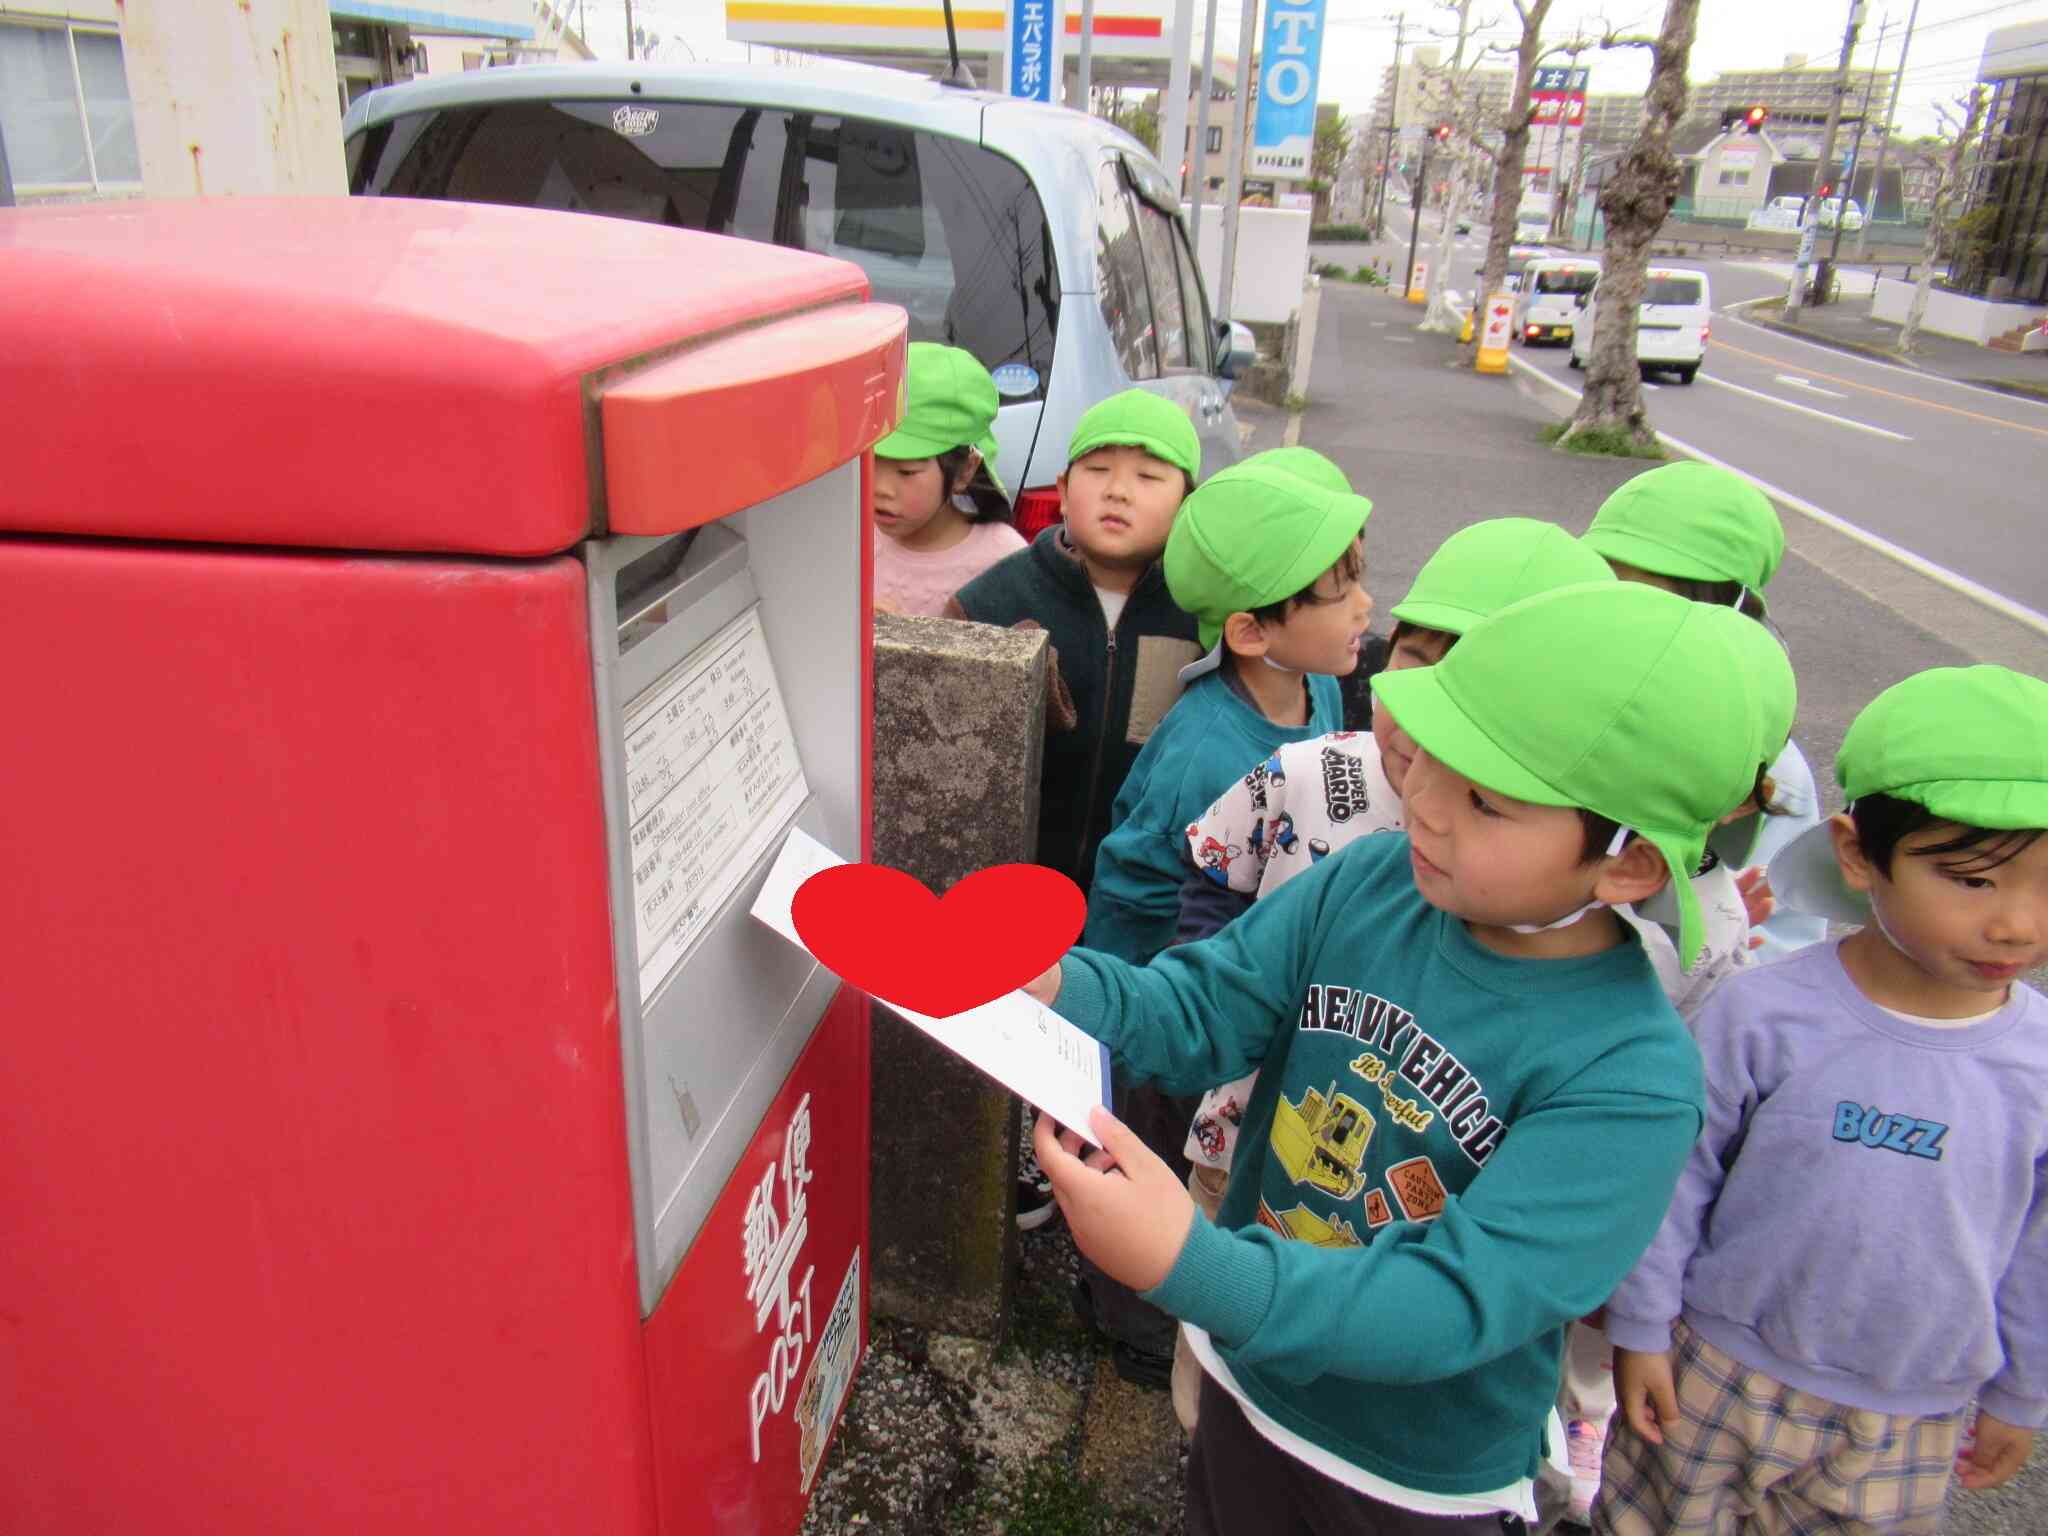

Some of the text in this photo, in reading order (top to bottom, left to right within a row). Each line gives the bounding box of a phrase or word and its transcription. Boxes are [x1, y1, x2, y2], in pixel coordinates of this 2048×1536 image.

[1266, 0, 1316, 105] TO
[1326, 748, 1352, 821] MARIO
[1346, 755, 1368, 813] SUPER
[1300, 984, 1508, 1168] HEAVY EHICL
[1832, 1101, 1949, 1160] BUZZ
[750, 1264, 815, 1464] POST
